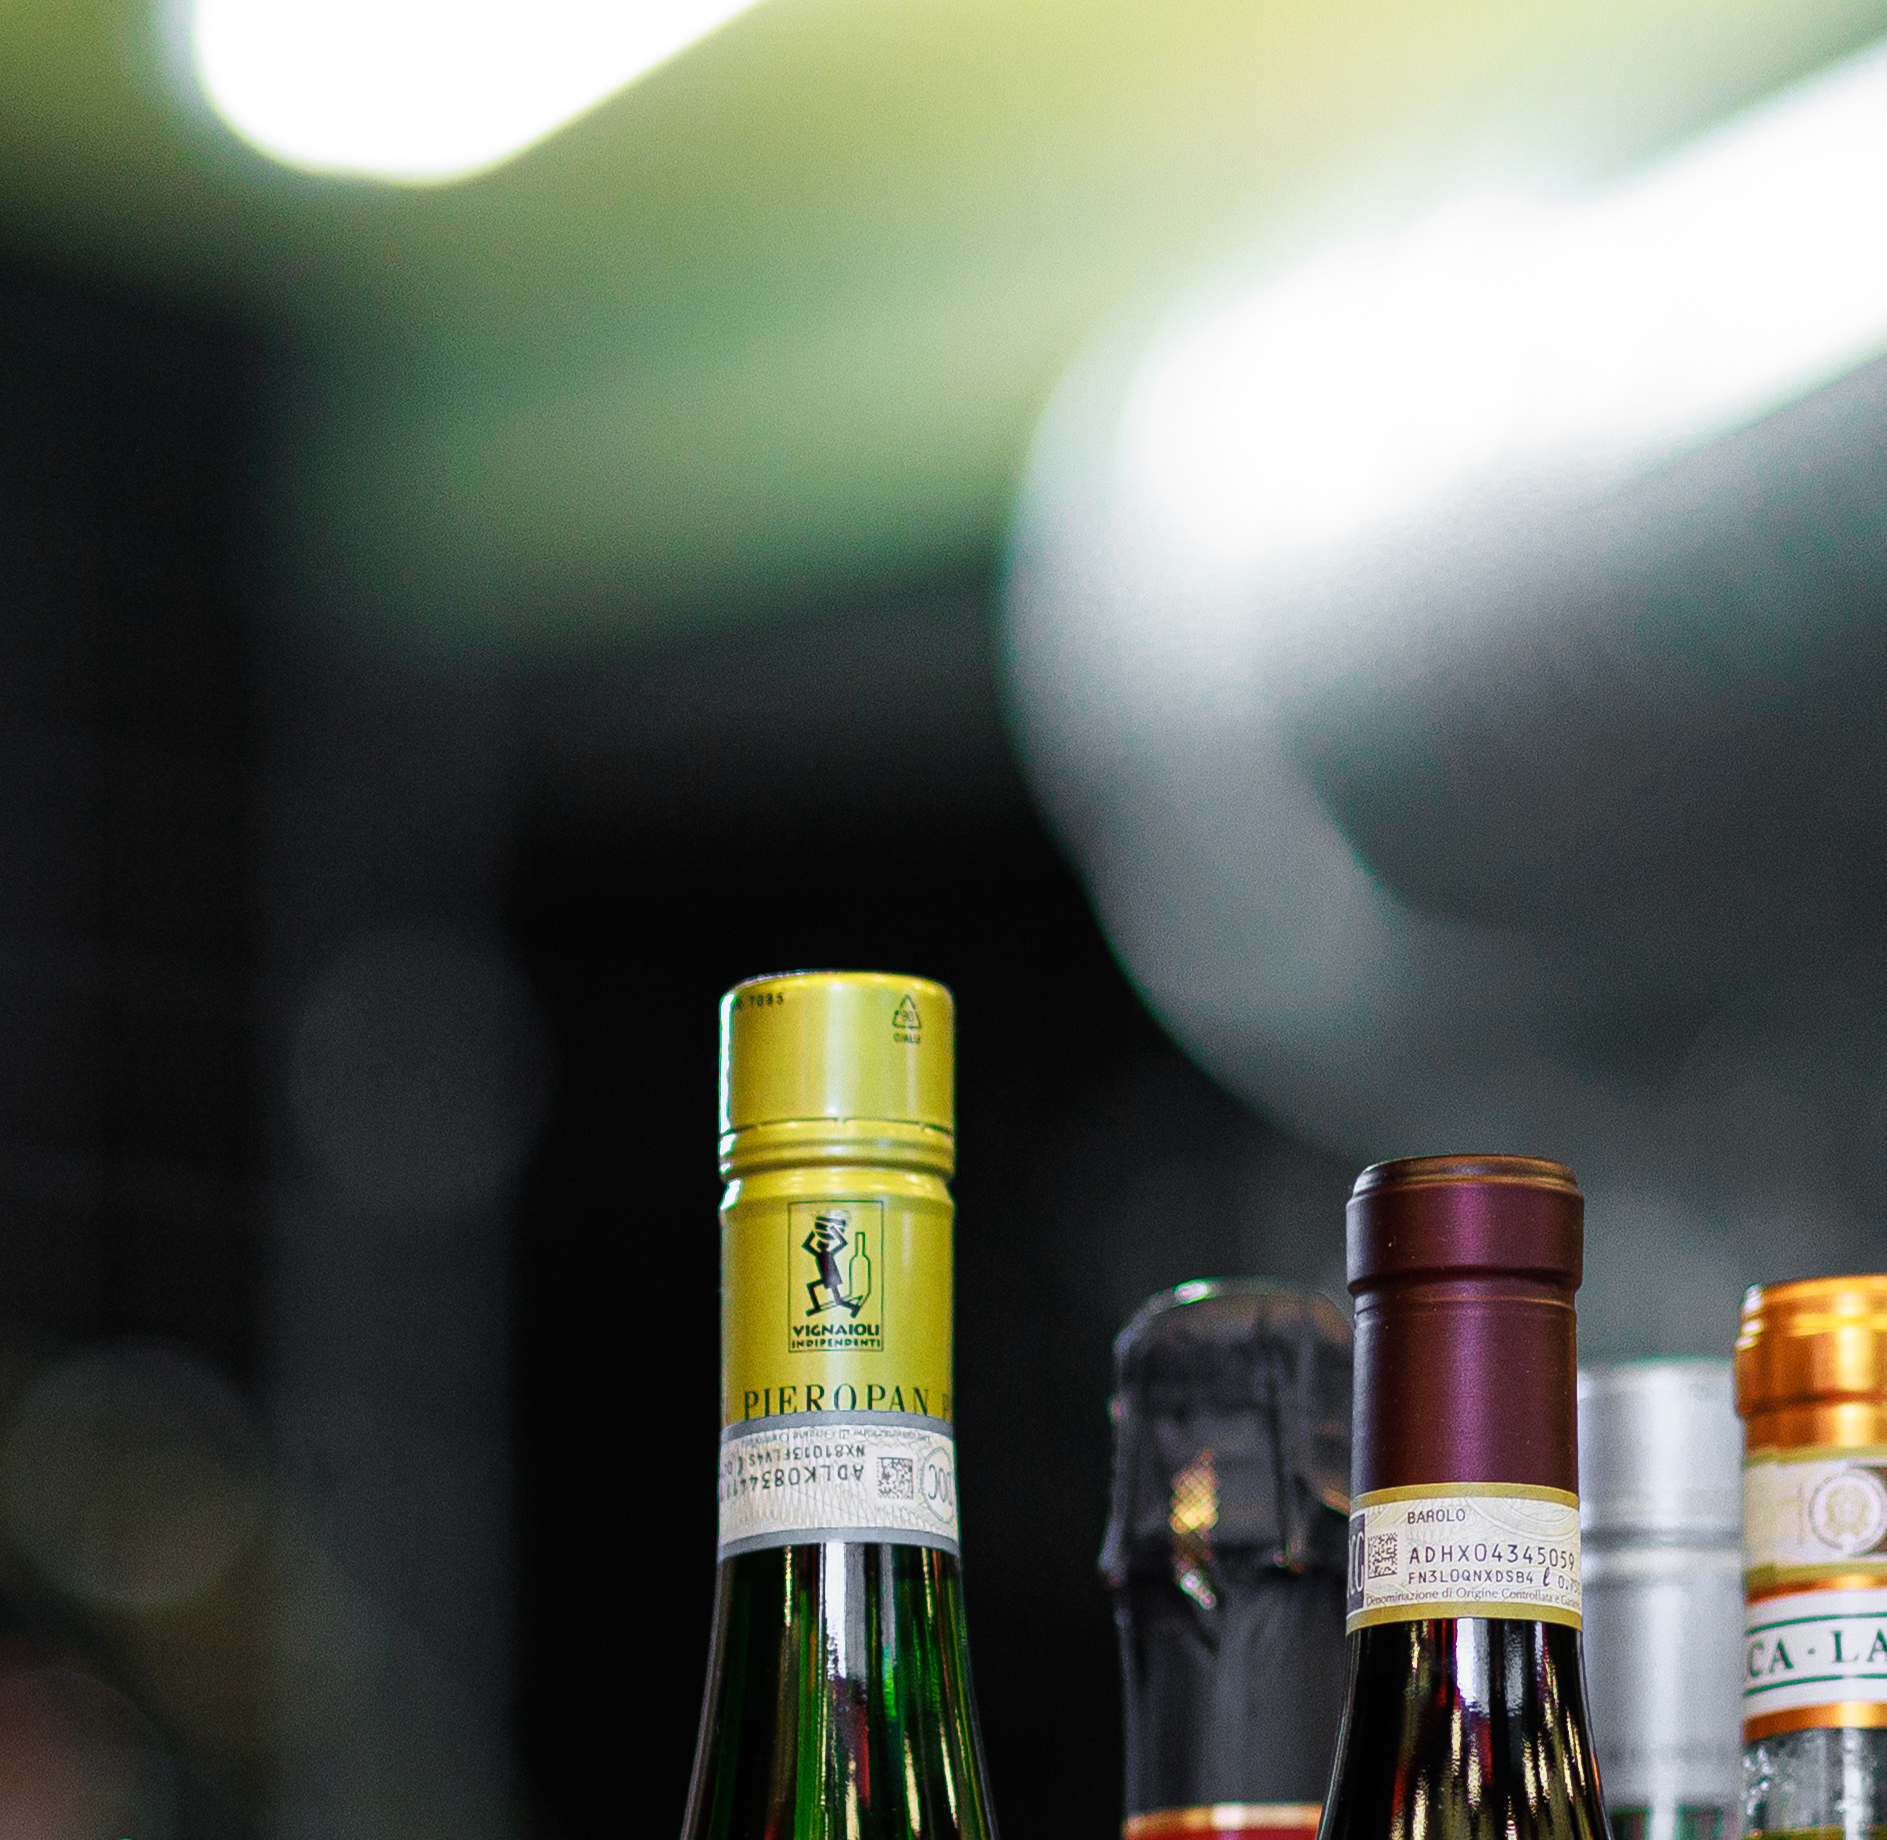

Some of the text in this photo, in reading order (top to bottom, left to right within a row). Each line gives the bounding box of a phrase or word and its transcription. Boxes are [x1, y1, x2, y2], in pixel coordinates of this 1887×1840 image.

[792, 1322, 880, 1337] VIGNAIOLI
[791, 1338, 881, 1349] INDIPENDENTI
[743, 1382, 929, 1421] PIEROPAN
[1407, 1508, 1466, 1525] BAROLO
[1441, 1586, 1453, 1599] di
[1455, 1586, 1499, 1601] Origine
[1746, 1637, 1795, 1678] CA
